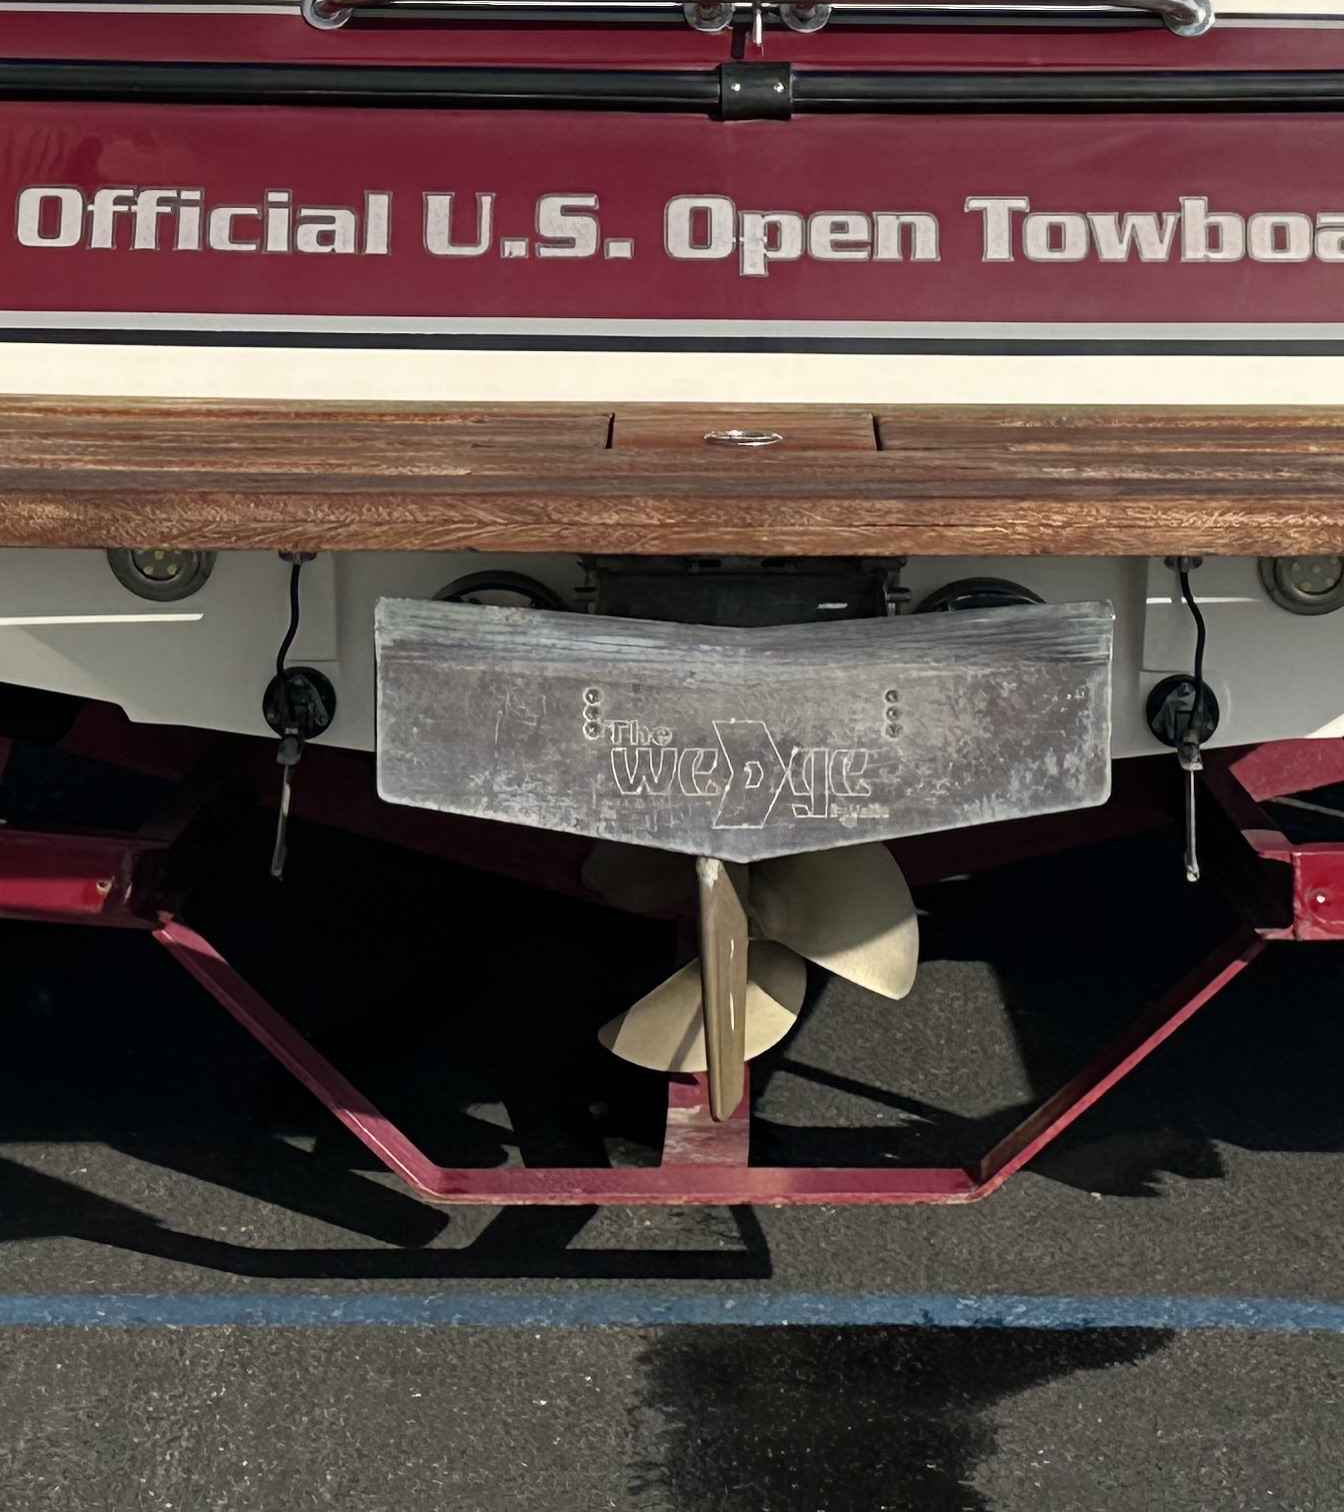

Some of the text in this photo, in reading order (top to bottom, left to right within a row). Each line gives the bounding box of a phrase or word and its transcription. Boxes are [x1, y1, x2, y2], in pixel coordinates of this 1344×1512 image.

[15, 185, 393, 256] Official
[421, 190, 636, 260] U.S.
[664, 192, 942, 279] Open
[603, 719, 673, 748] The
